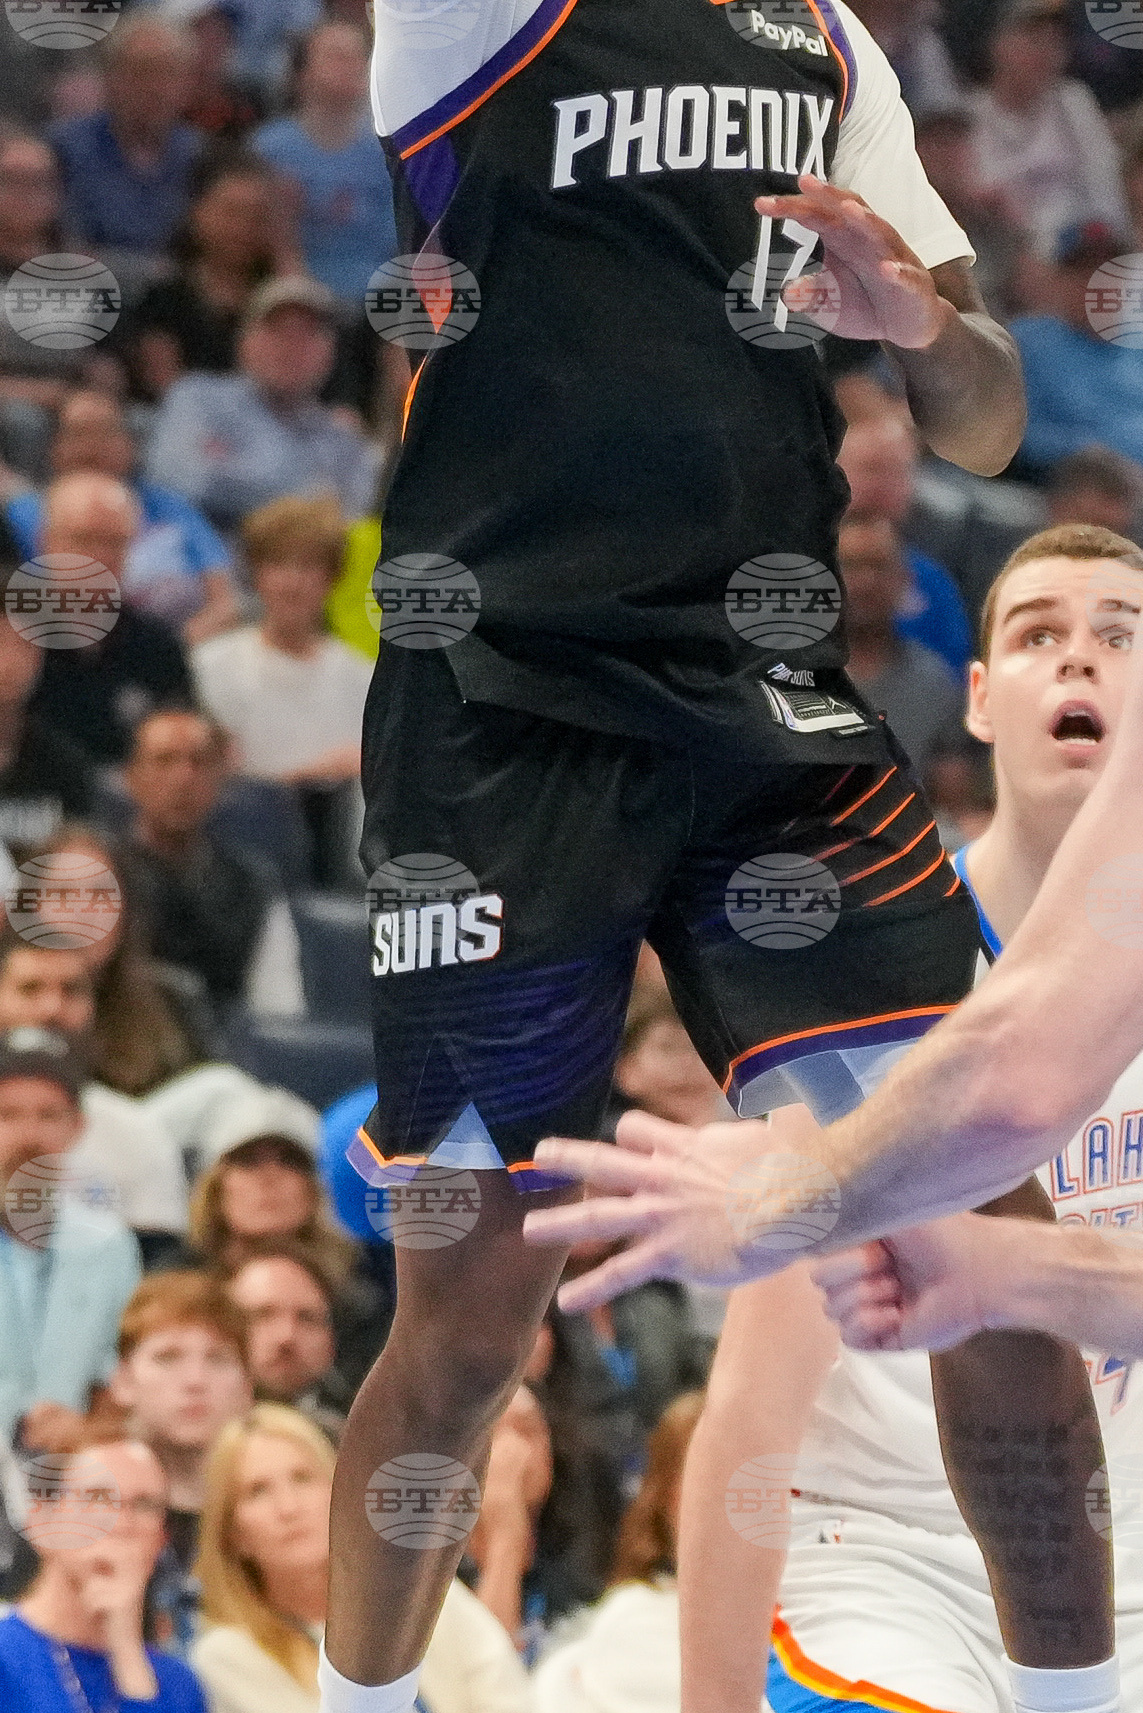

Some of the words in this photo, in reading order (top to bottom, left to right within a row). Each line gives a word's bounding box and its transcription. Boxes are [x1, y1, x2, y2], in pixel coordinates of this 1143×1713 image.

[751, 9, 828, 57] PayPal
[552, 84, 835, 189] PHOENIX
[372, 892, 504, 977] SUNS
